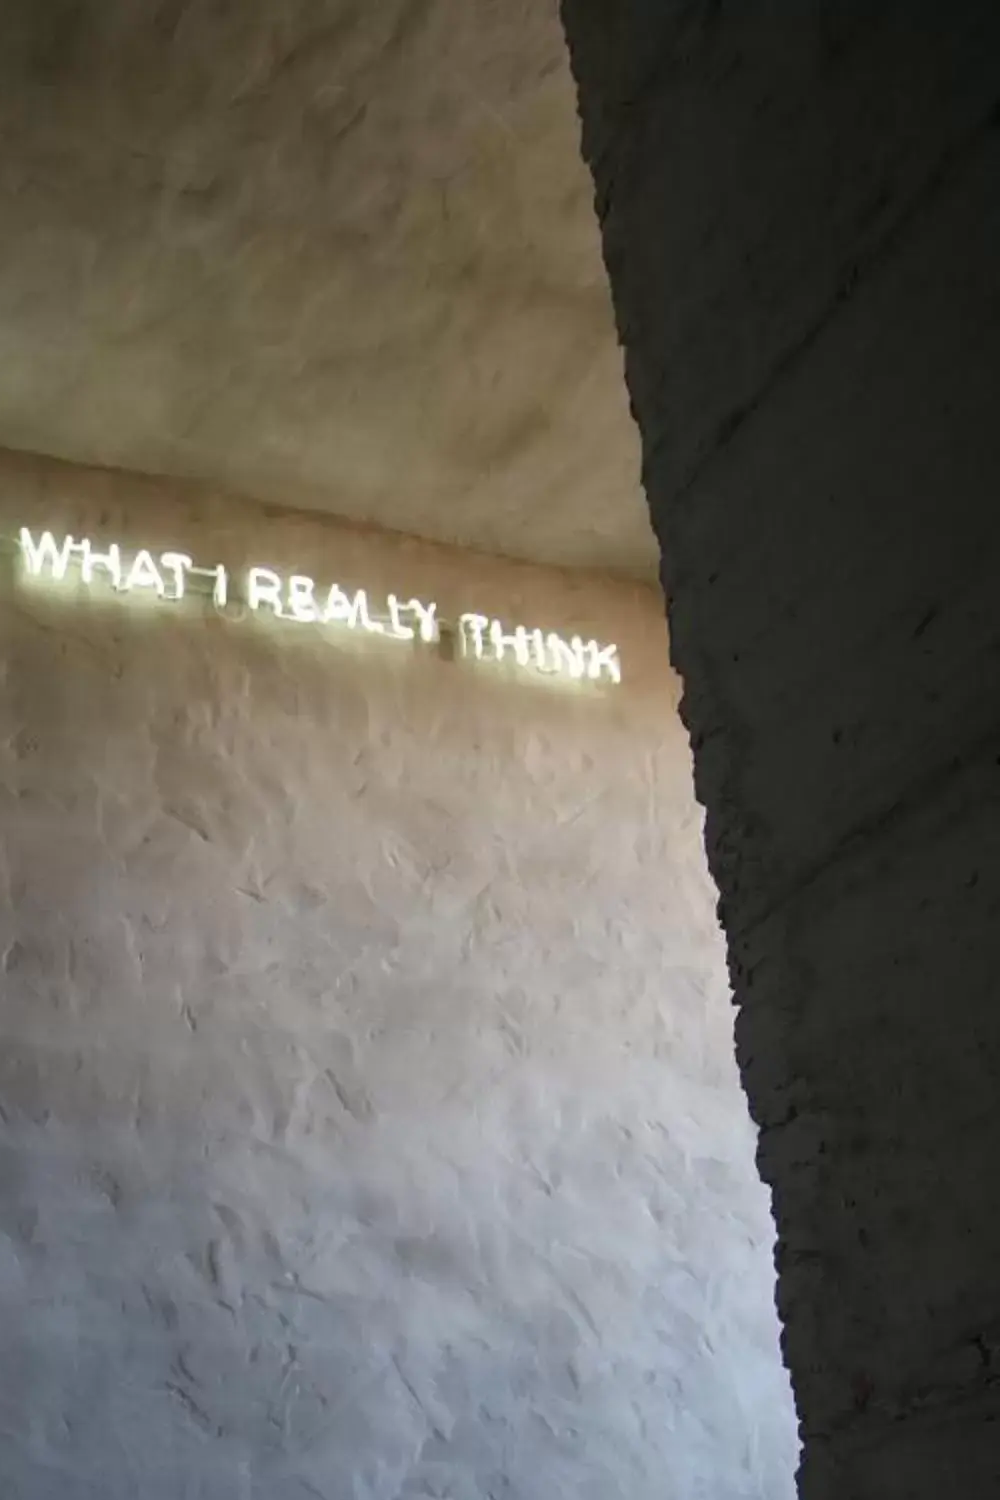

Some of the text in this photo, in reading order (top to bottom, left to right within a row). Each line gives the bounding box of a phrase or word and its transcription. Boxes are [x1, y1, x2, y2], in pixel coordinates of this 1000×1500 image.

[20, 527, 191, 600] WHAT
[213, 563, 228, 606] I
[248, 568, 438, 642] REALLY
[460, 613, 621, 684] THINK
